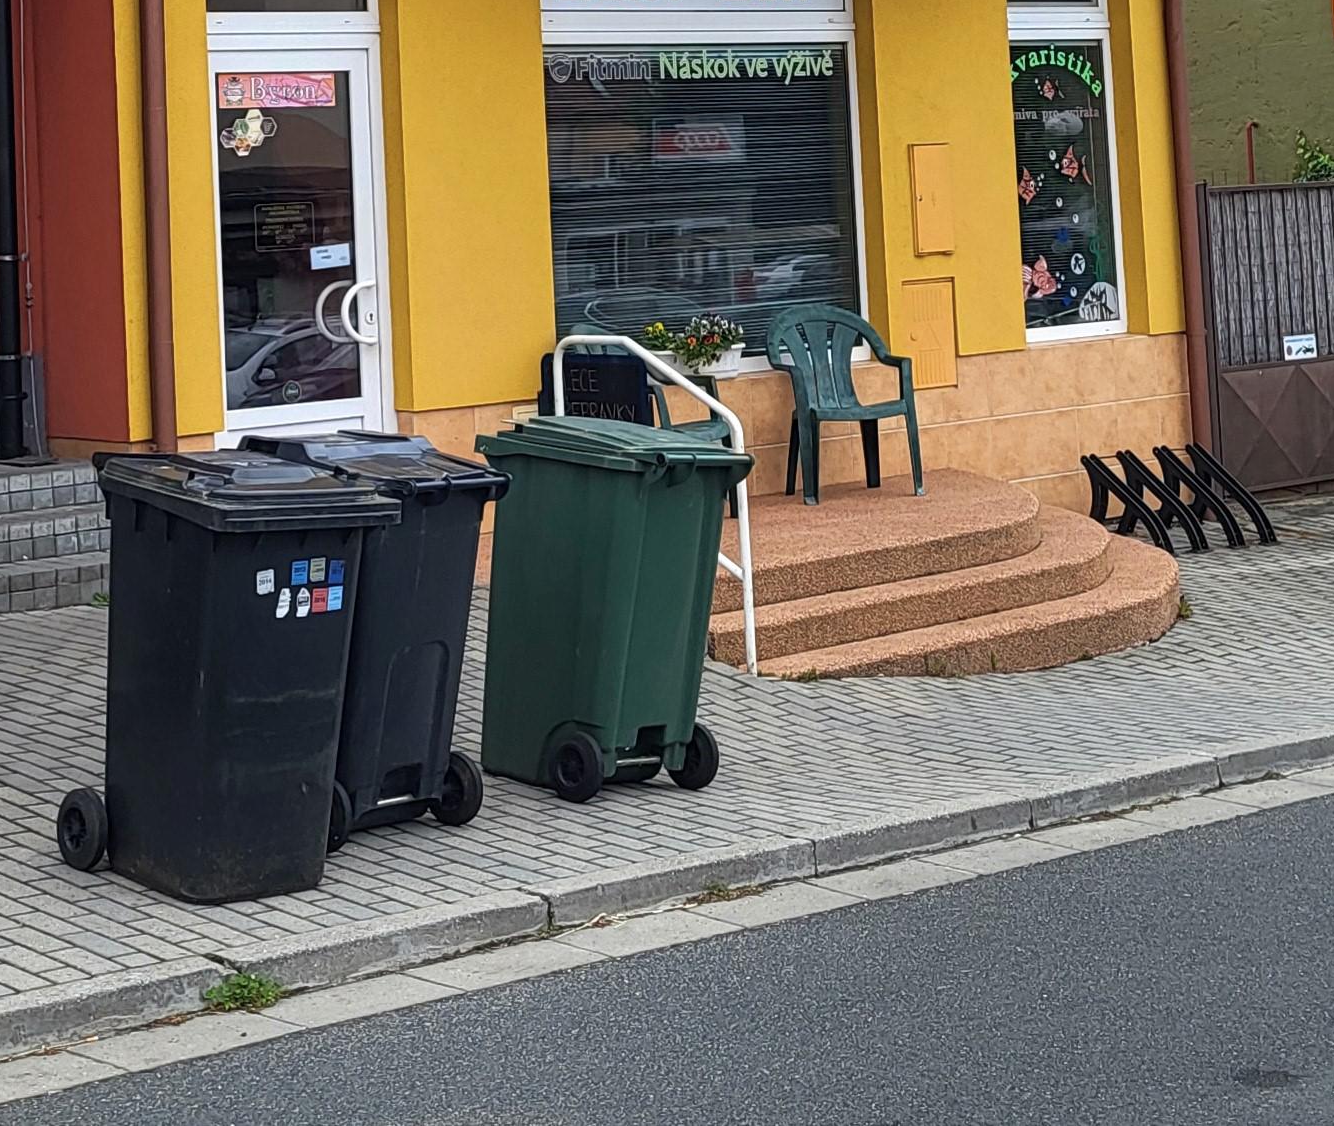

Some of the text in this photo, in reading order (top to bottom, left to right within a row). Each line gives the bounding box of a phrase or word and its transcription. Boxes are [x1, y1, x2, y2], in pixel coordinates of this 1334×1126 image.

[574, 49, 835, 86] Fitmin Náskok ve výživě
[1010, 43, 1103, 98] kvaristika
[250, 76, 316, 105] Byron
[568, 368, 600, 392] ECE
[567, 401, 635, 422] EPRAVKY
